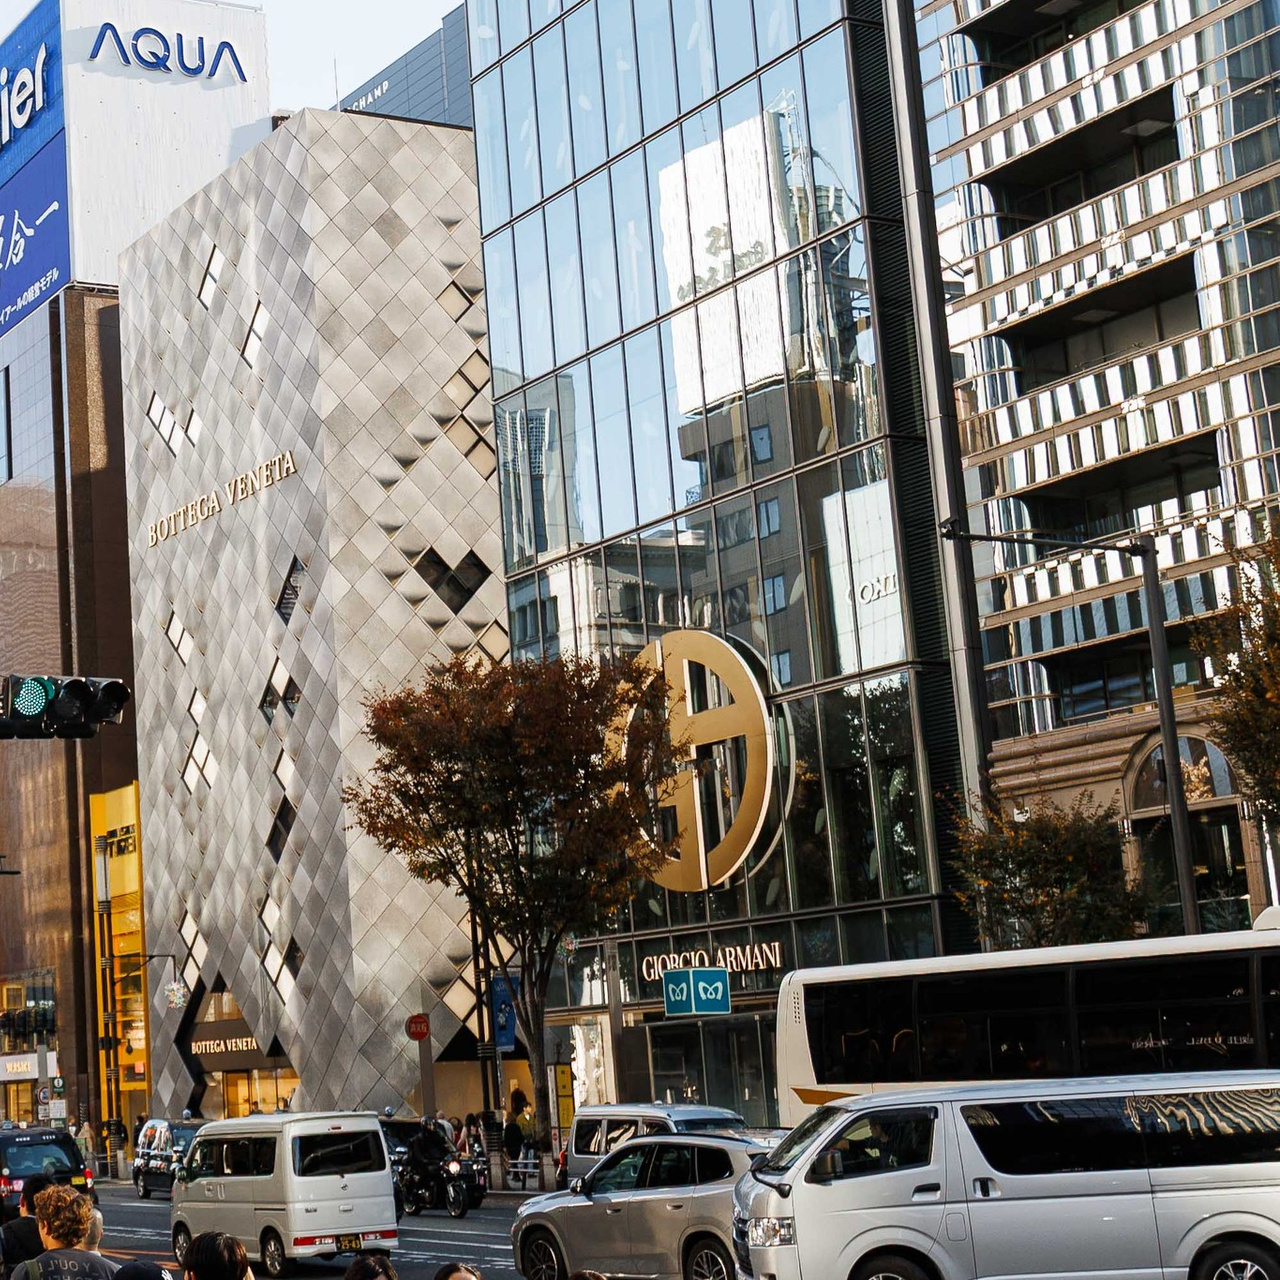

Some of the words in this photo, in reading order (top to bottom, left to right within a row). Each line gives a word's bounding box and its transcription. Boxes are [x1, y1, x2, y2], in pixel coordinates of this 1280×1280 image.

[89, 21, 248, 84] AQUA
[347, 81, 389, 111] CHAMP
[147, 491, 222, 548] BOTTEGA
[225, 450, 297, 505] VENETA
[716, 942, 781, 972] ARMANI
[191, 1040, 225, 1055] BOTTEGA
[226, 1037, 257, 1051] VENETA
